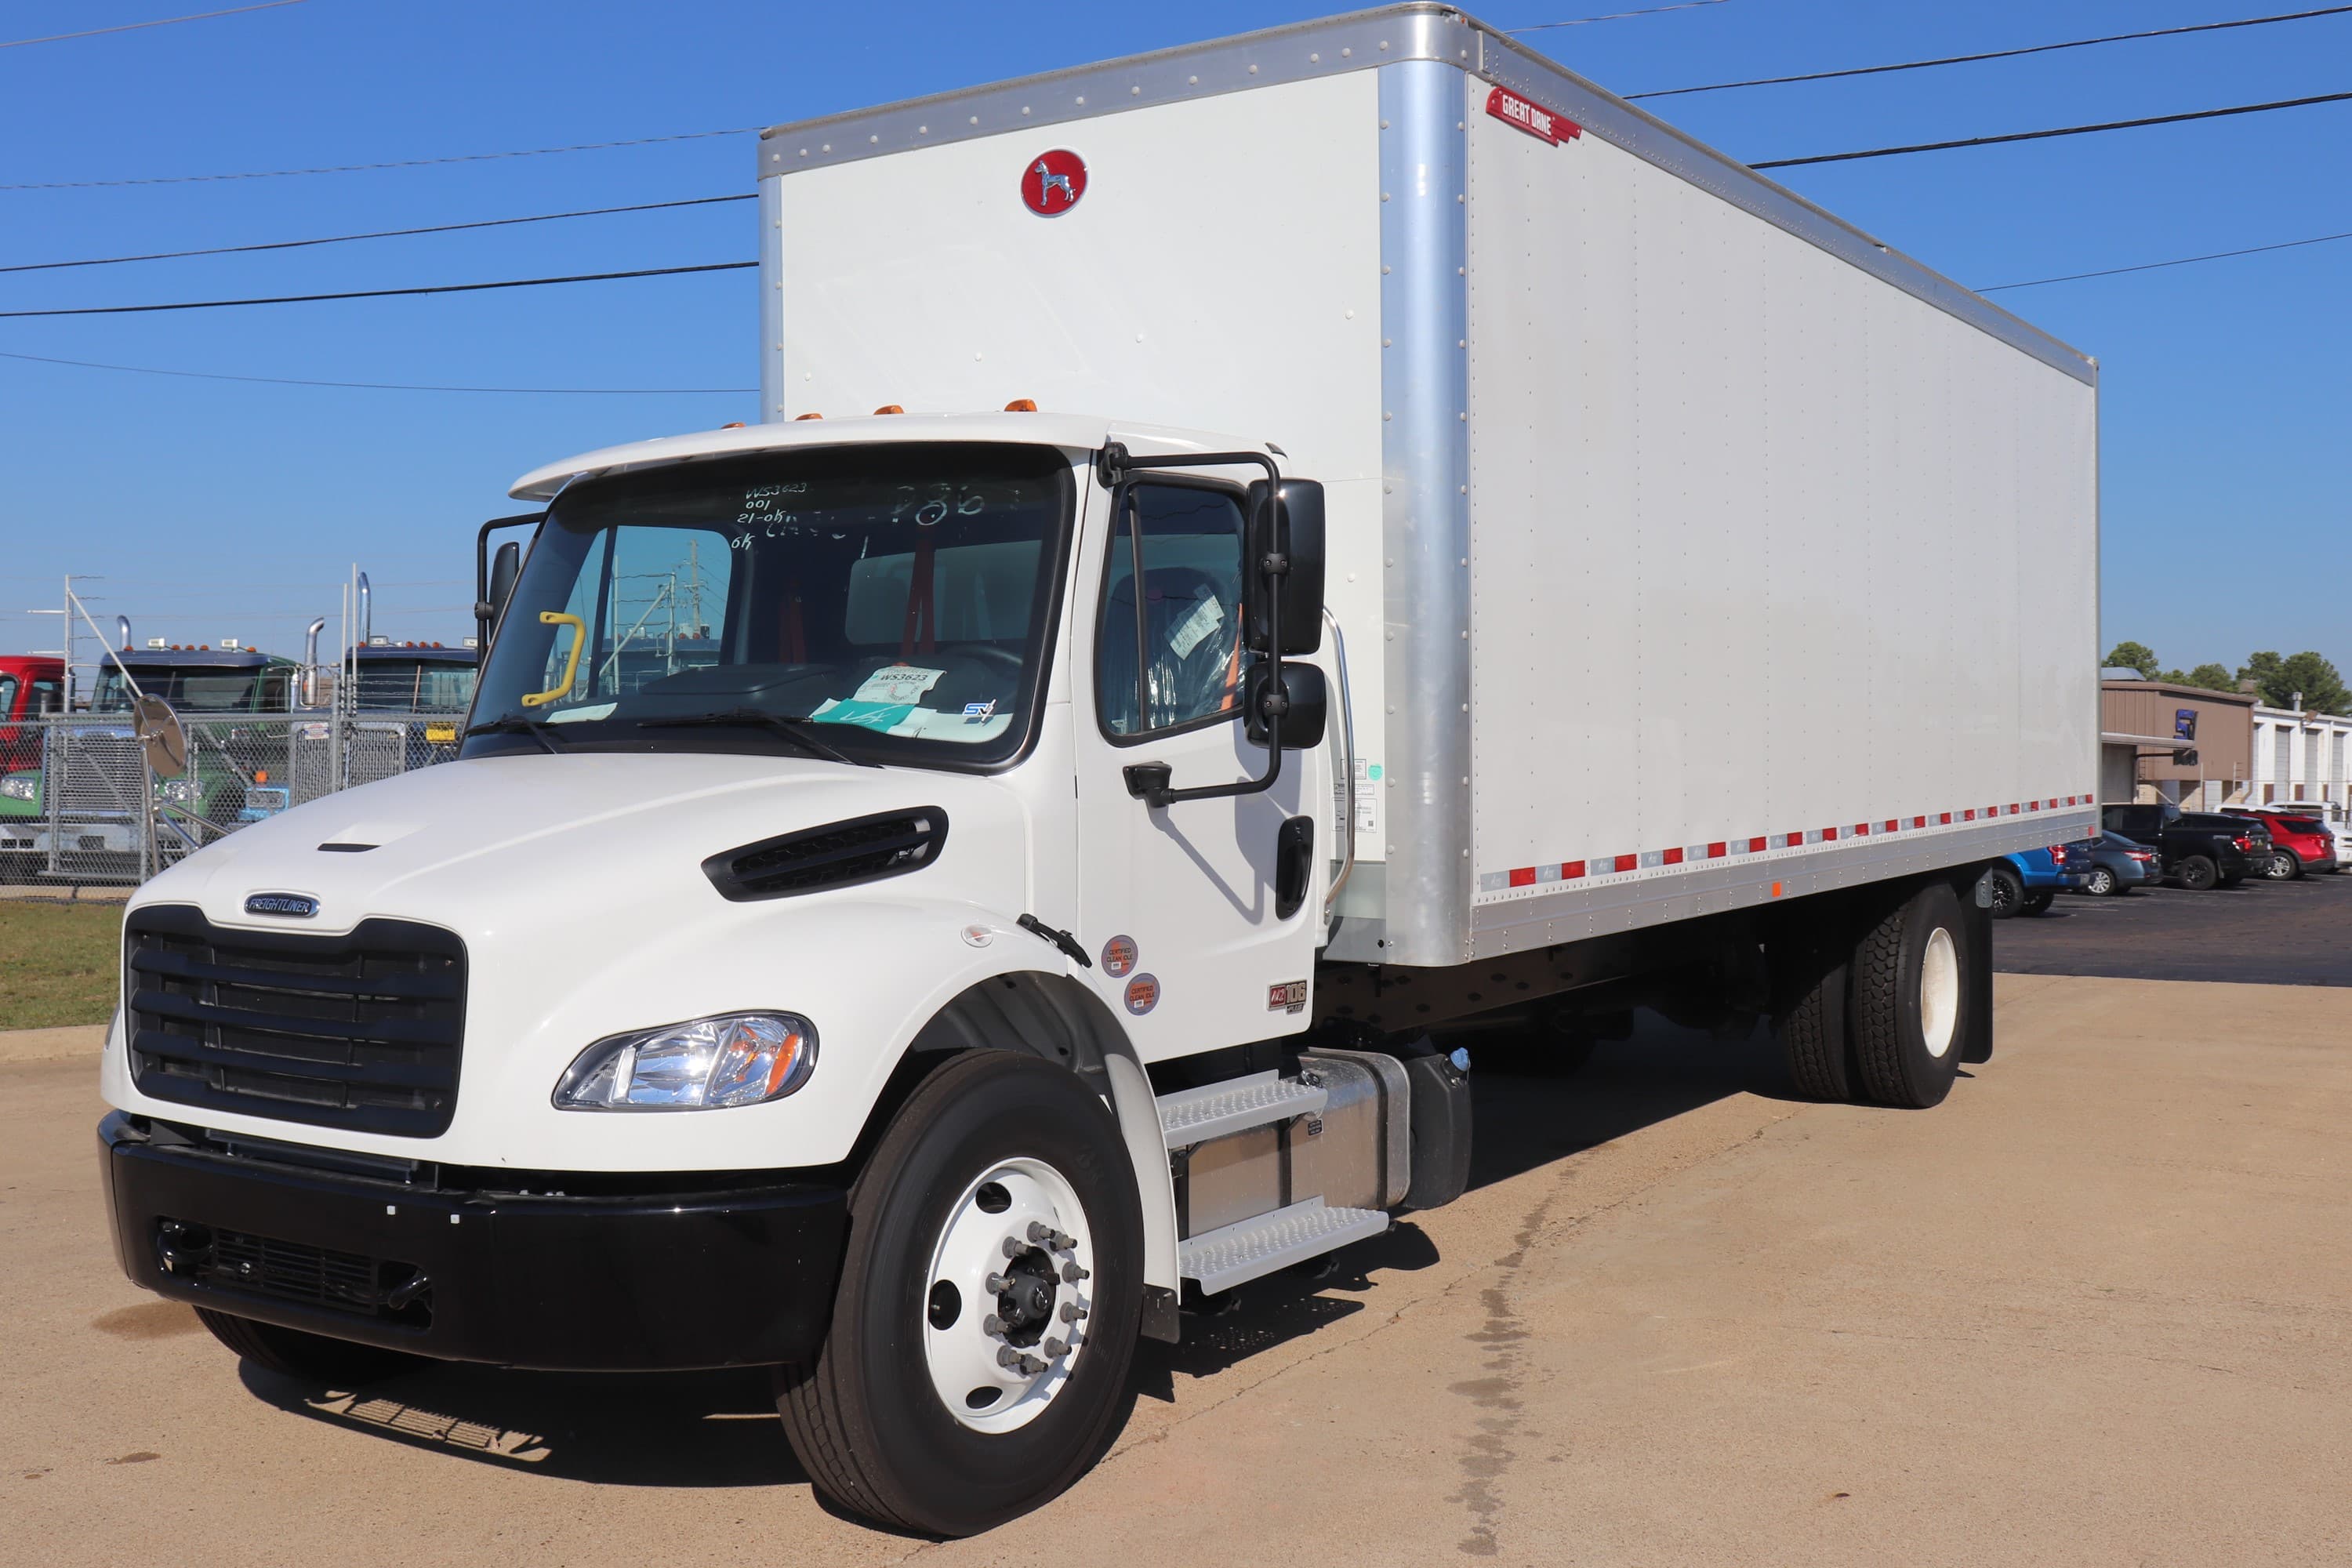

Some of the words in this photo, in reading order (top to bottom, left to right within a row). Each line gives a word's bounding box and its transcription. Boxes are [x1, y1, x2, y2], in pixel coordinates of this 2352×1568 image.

[1502, 94, 1530, 124] GREAT
[1531, 107, 1552, 136] DANE
[746, 482, 808, 499] WS3623
[746, 499, 770, 510] 001
[249, 898, 310, 913] FREIGHTLINER
[1109, 947, 1131, 956] CERTIFIED
[1131, 985, 1154, 994] CERTIFIED
[1271, 987, 1285, 1003] M2
[1287, 982, 1305, 1004] 106
